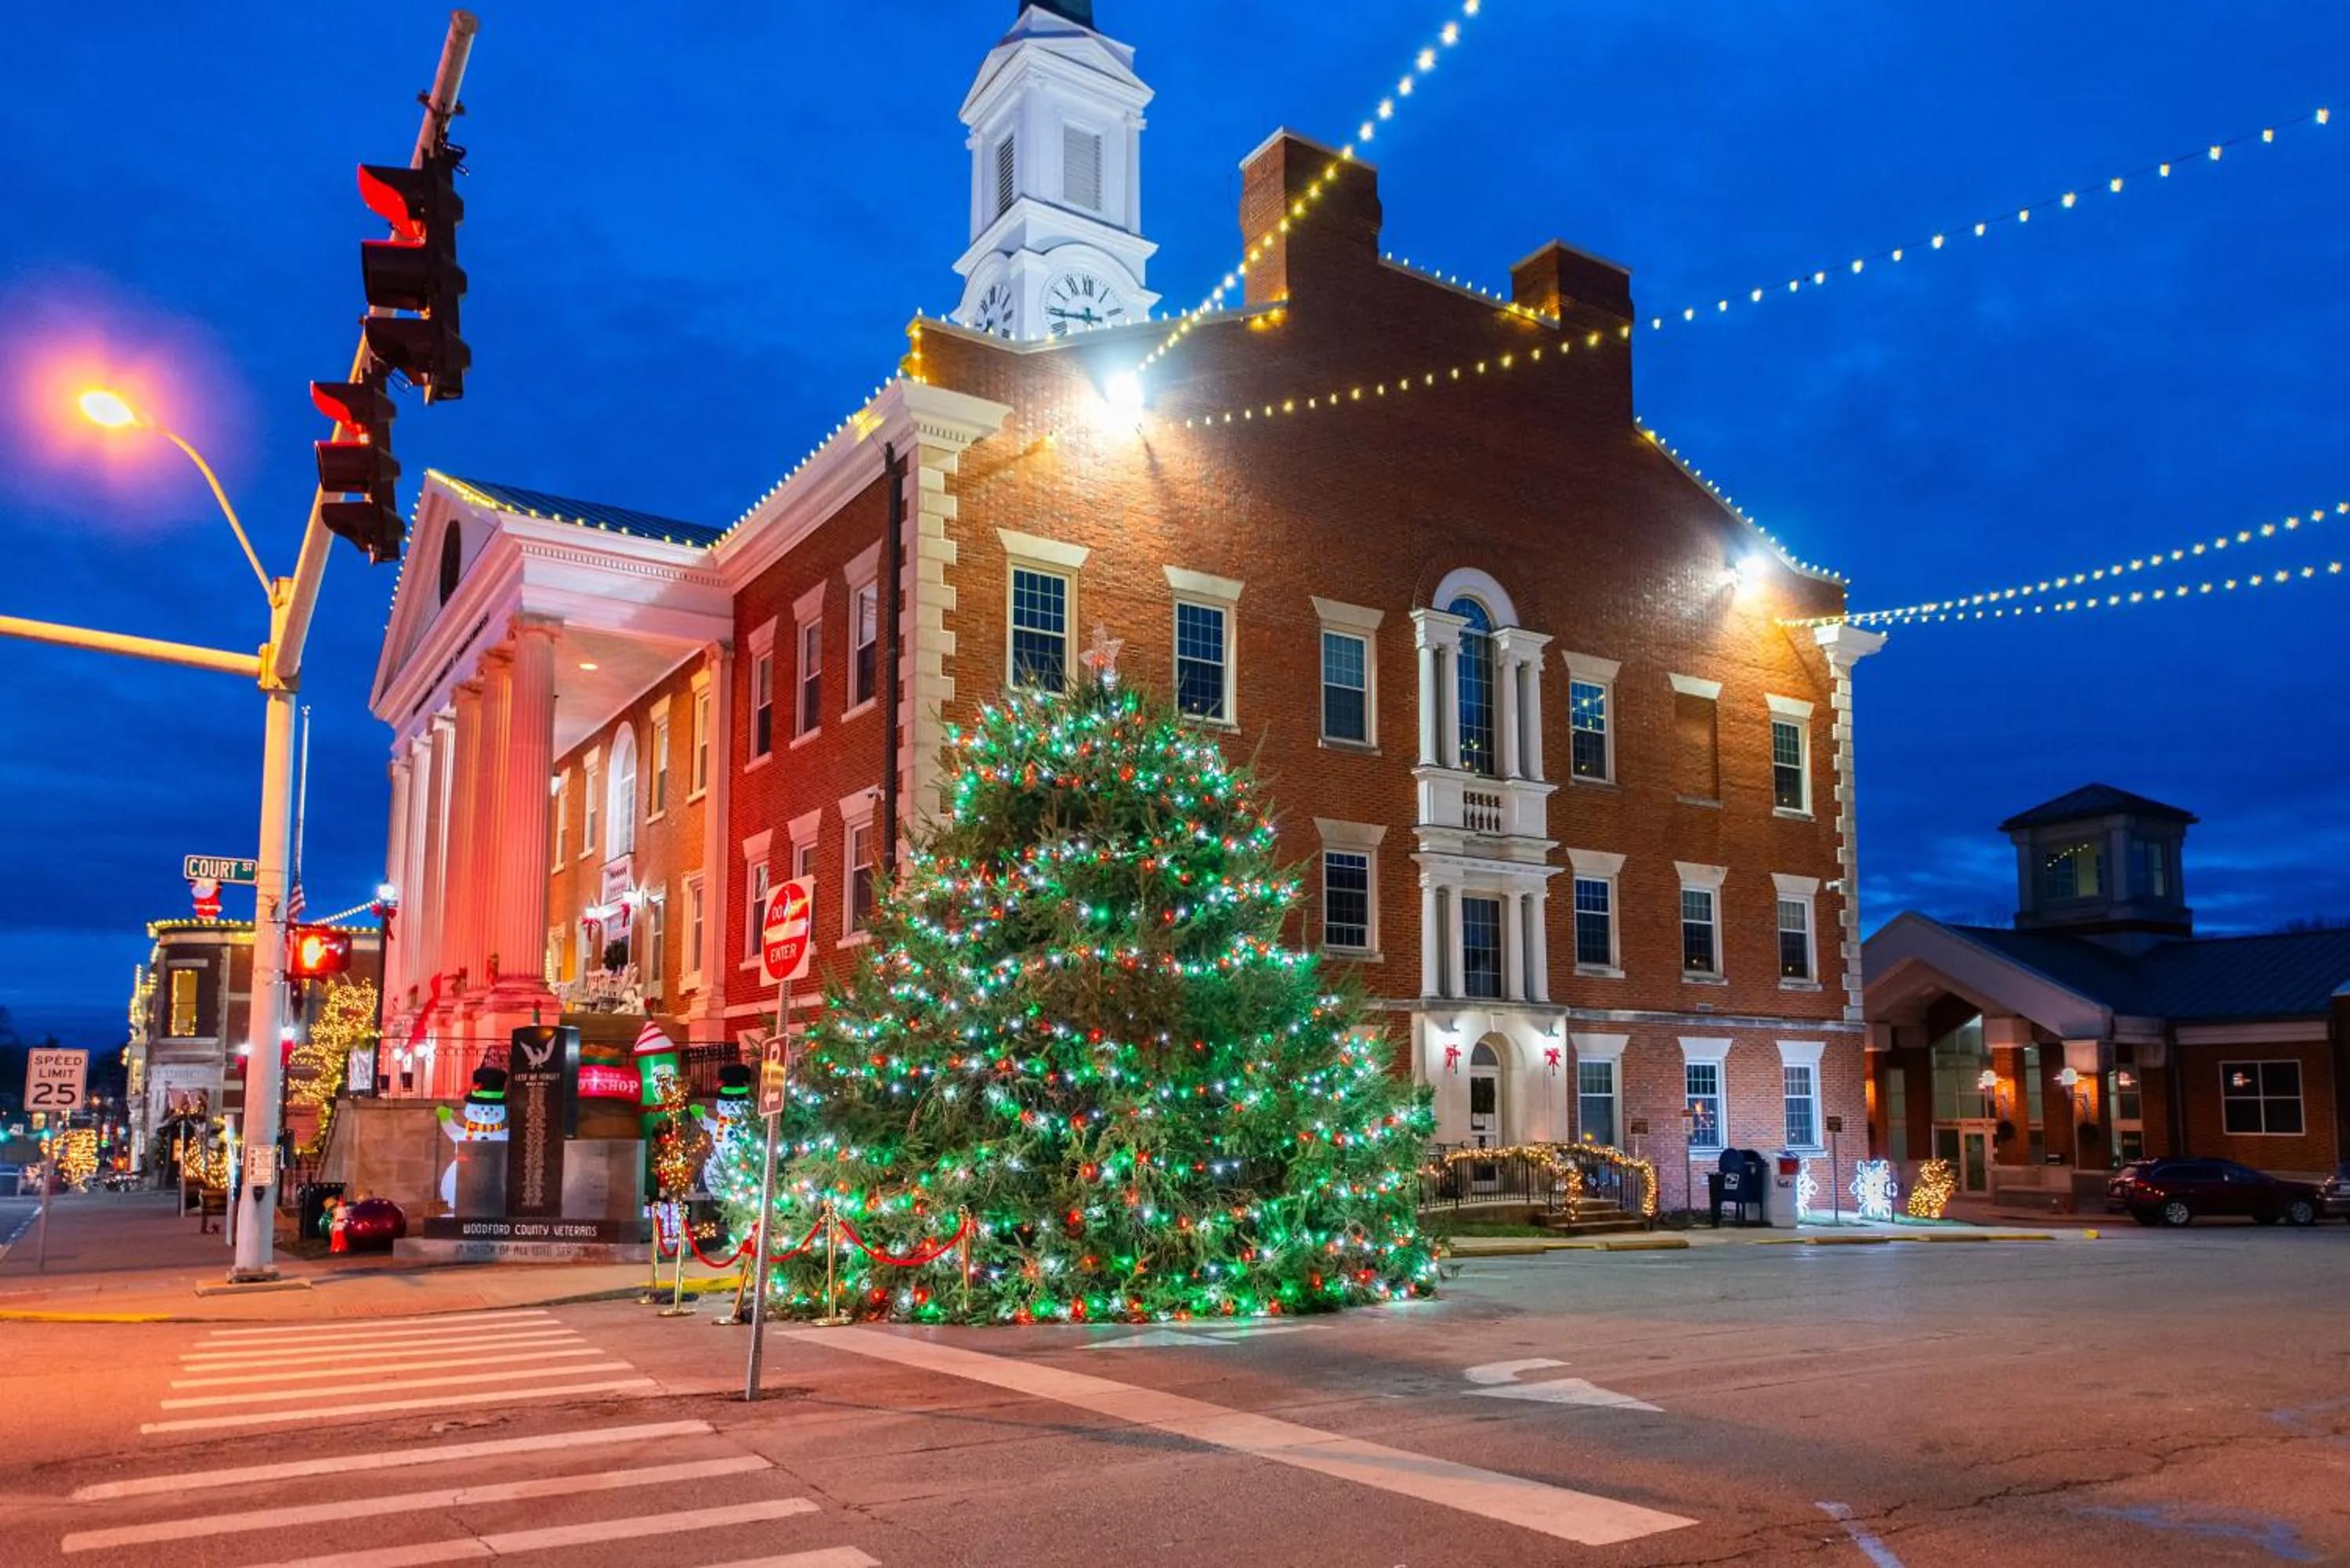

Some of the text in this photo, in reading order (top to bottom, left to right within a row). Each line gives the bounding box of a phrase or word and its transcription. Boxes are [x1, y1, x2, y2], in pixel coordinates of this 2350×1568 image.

[189, 859, 253, 877] COURT ST
[770, 943, 797, 963] ENTER
[34, 1055, 82, 1066] SPEED
[38, 1068, 75, 1078] LIMIT
[33, 1082, 76, 1104] 25
[600, 1080, 638, 1093] SHOP
[463, 1223, 598, 1237] WOODFORD COUNTY VETERANS
